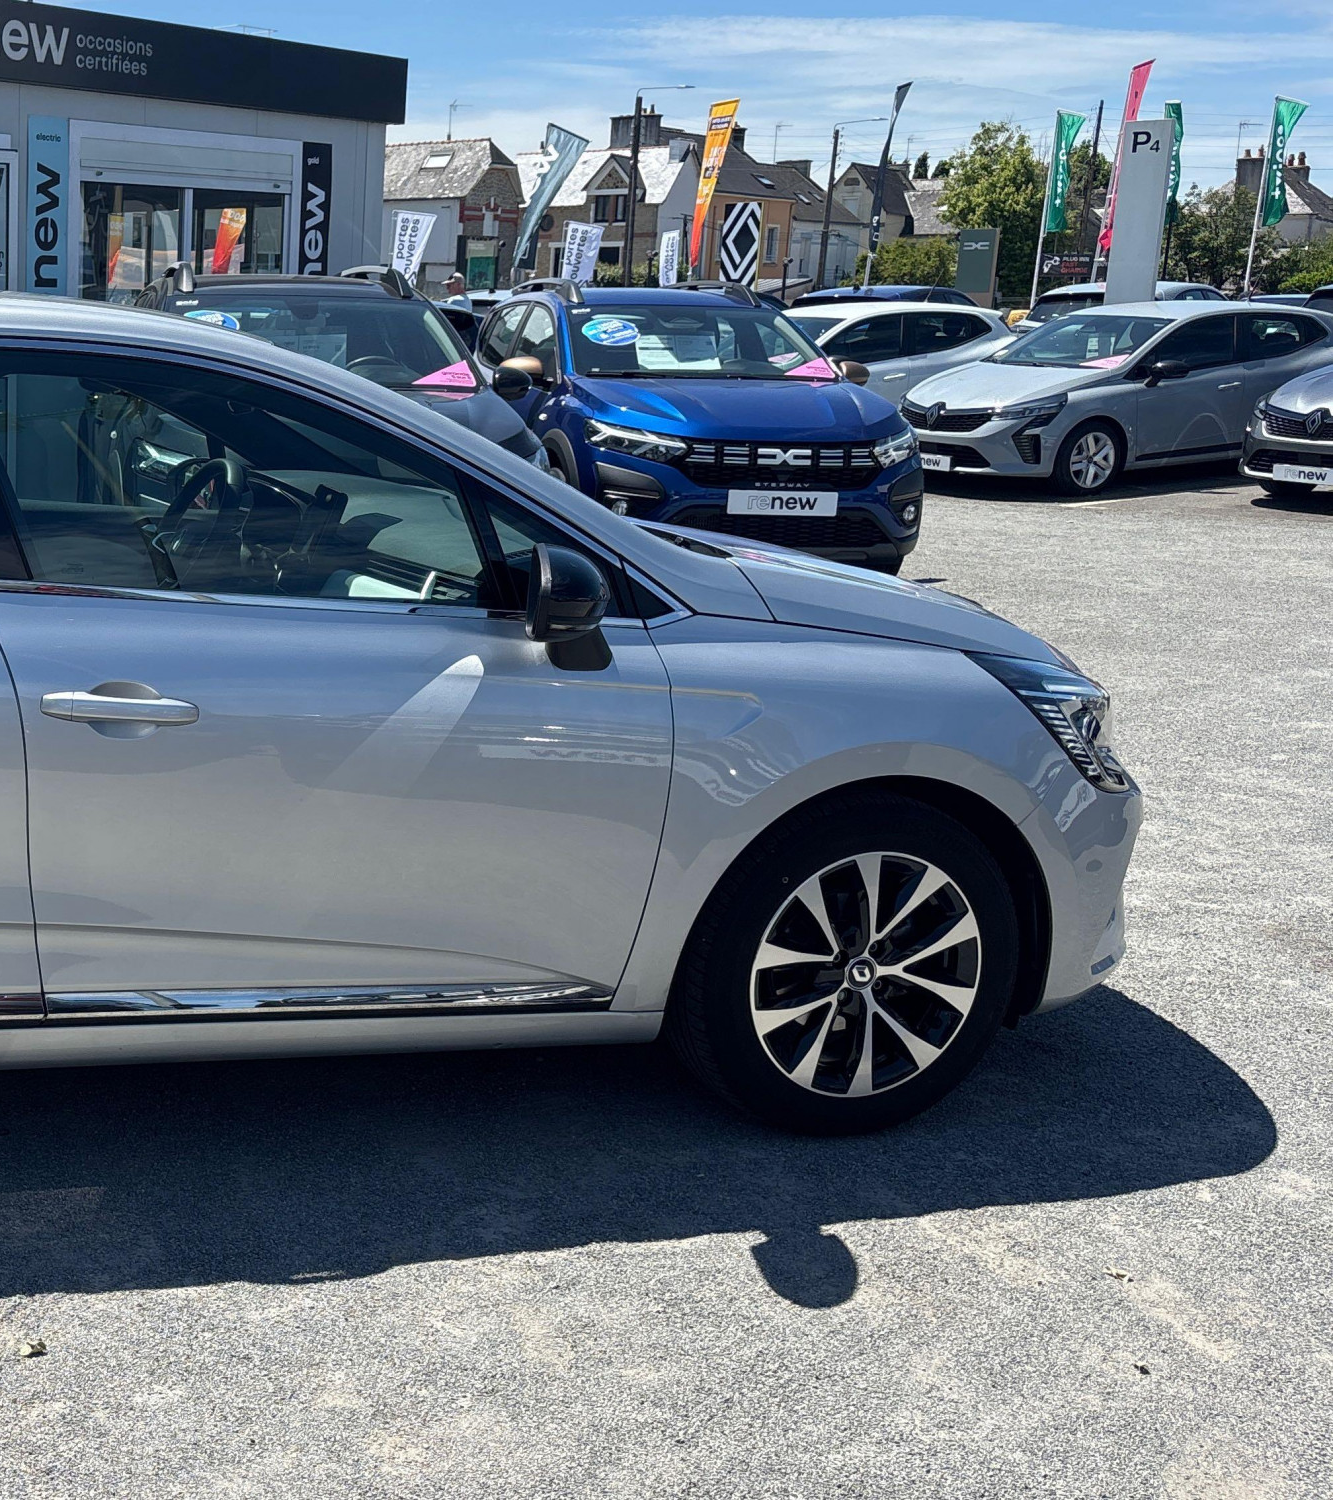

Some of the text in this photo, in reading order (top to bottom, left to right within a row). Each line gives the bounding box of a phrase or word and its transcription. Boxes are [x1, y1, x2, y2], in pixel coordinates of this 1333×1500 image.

[76, 33, 153, 57] occasions
[76, 53, 148, 75] certifiées
[36, 132, 62, 142] electric
[307, 156, 320, 165] gold
[396, 217, 410, 260] portes
[404, 218, 420, 276] ouvertes
[565, 227, 579, 266] portes
[570, 229, 588, 280] ouvertes
[1284, 468, 1328, 481] renew
[747, 495, 818, 510] renew
